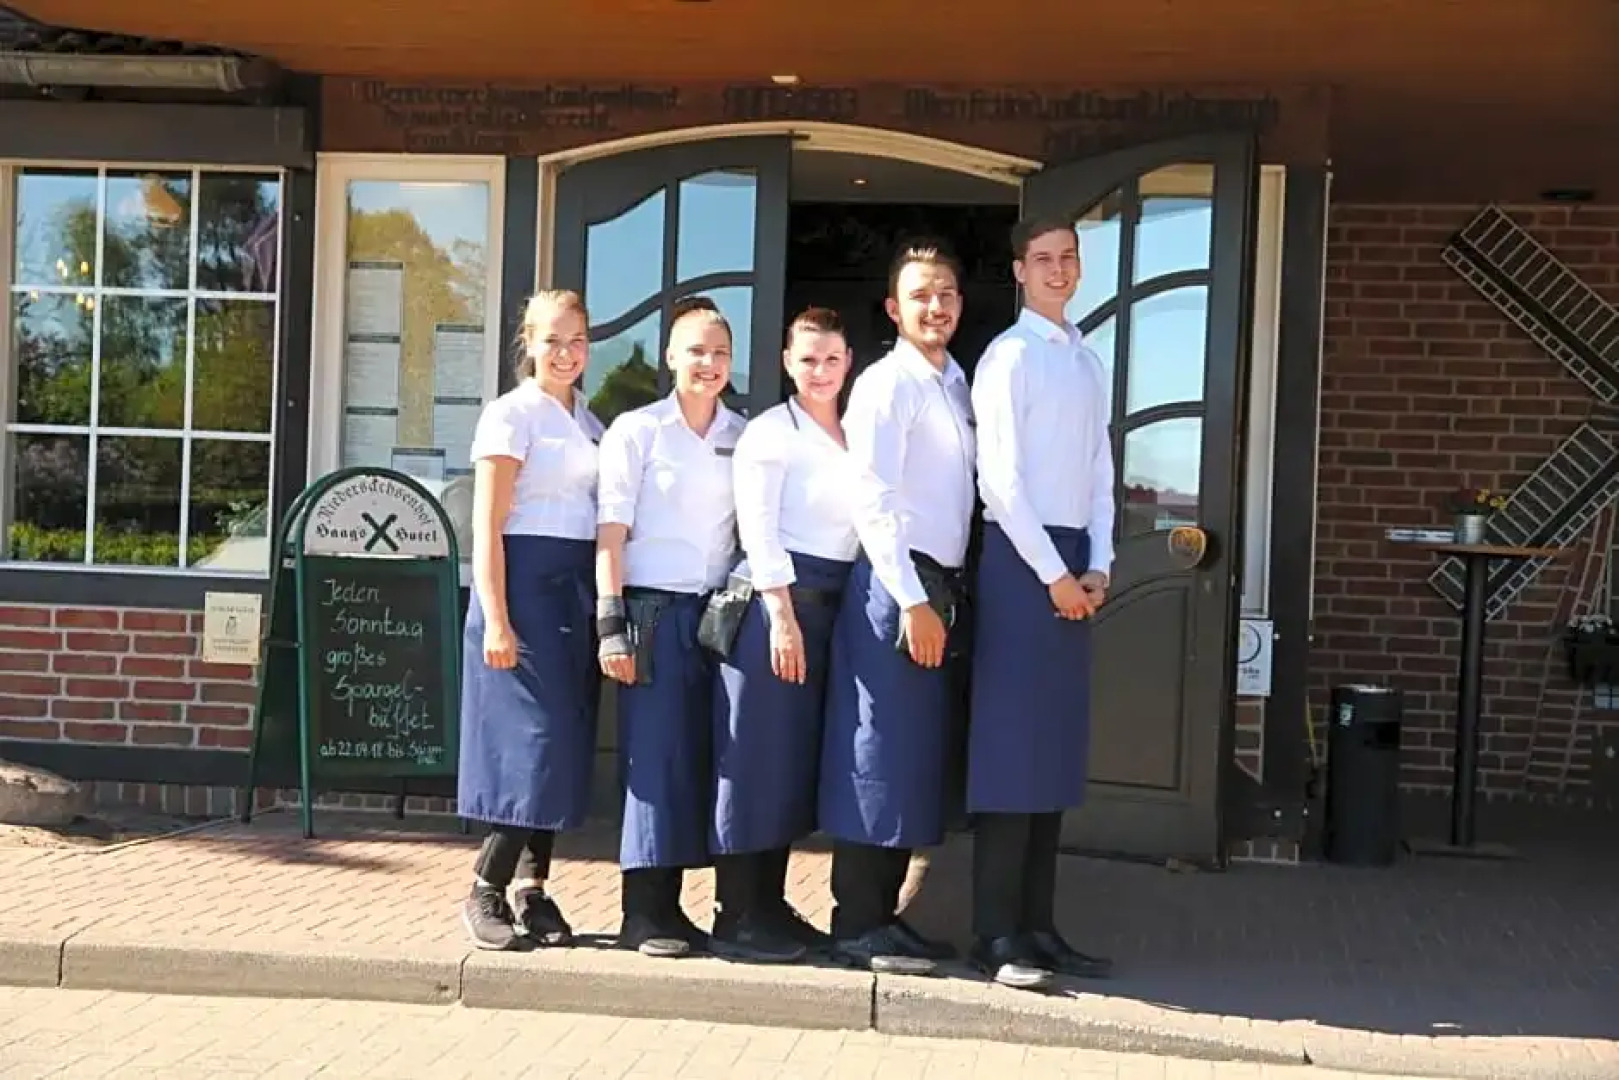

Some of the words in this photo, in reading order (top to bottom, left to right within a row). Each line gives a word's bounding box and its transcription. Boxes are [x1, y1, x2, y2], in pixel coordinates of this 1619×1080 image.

[396, 526, 437, 542] Hotel
[322, 578, 380, 605] Jeden
[331, 606, 423, 644] Sonntag
[324, 642, 387, 674] großes
[320, 739, 336, 757] ab
[387, 741, 405, 758] bis
